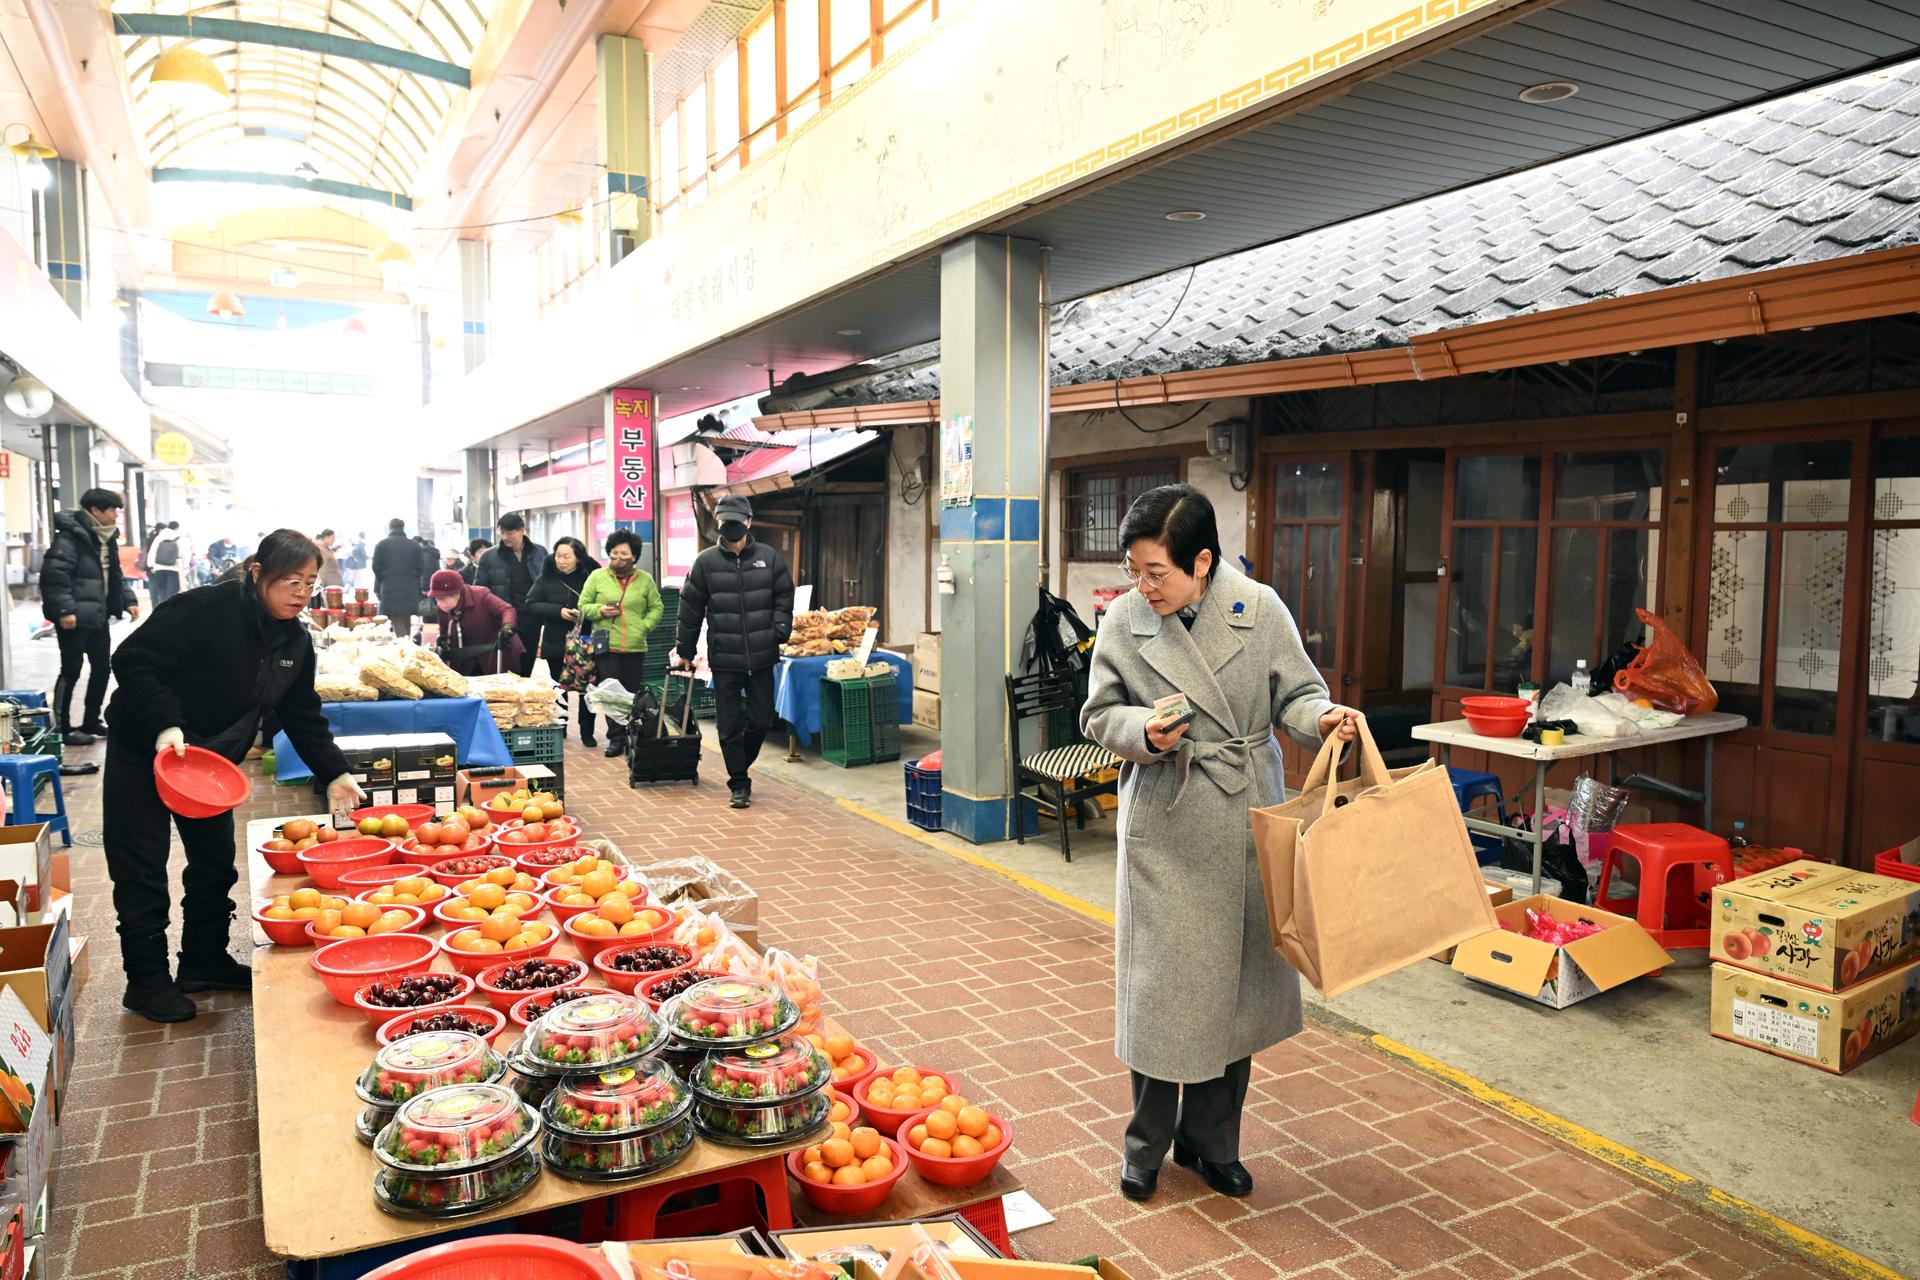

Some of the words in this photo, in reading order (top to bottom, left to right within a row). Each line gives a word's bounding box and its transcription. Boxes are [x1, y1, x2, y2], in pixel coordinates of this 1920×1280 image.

[615, 398, 649, 419] 녹지
[620, 427, 647, 511] 부동산
[1776, 943, 1821, 969] 사과
